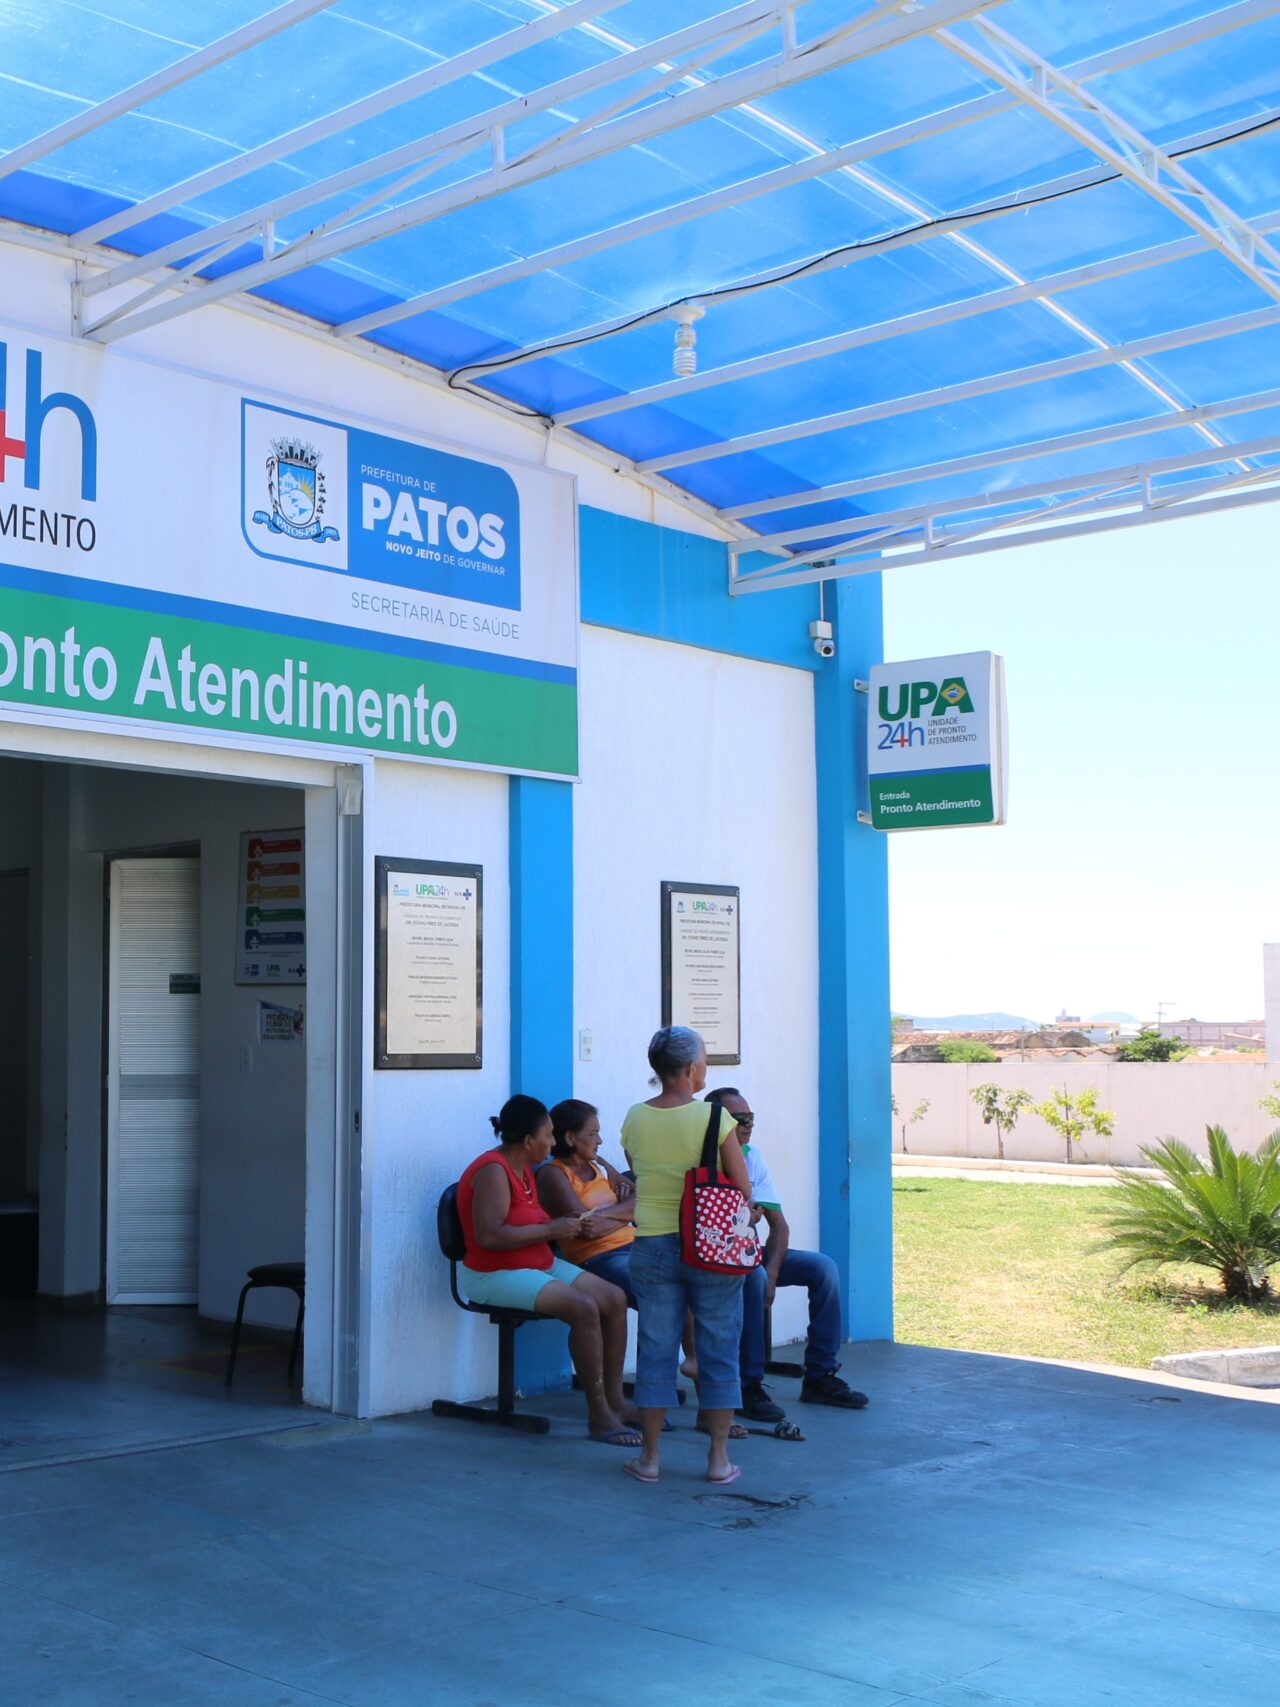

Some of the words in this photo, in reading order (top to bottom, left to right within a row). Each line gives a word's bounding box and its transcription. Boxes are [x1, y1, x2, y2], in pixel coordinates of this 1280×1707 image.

[360, 464, 420, 489] PREFEITURA
[423, 481, 437, 493] DE
[362, 482, 506, 560] PATOS
[386, 541, 414, 556] NOVO
[415, 548, 441, 562] JEITO
[443, 554, 455, 565] DE
[457, 557, 506, 577] GOVERNAR
[351, 591, 444, 626] SECRETARIA
[449, 611, 468, 630] DE
[473, 616, 520, 640] SAÚDE
[133, 636, 457, 748] Atendimento
[878, 677, 975, 721] UPA
[877, 721, 925, 750] 24h
[927, 717, 959, 727] UNIDADE
[927, 728, 937, 736] DE
[938, 726, 966, 735] PRONTO
[927, 734, 977, 746] ATENDIMENTO
[879, 791, 910, 801] Entrada
[880, 803, 913, 814] Pronto
[915, 798, 981, 812] Atendimento
